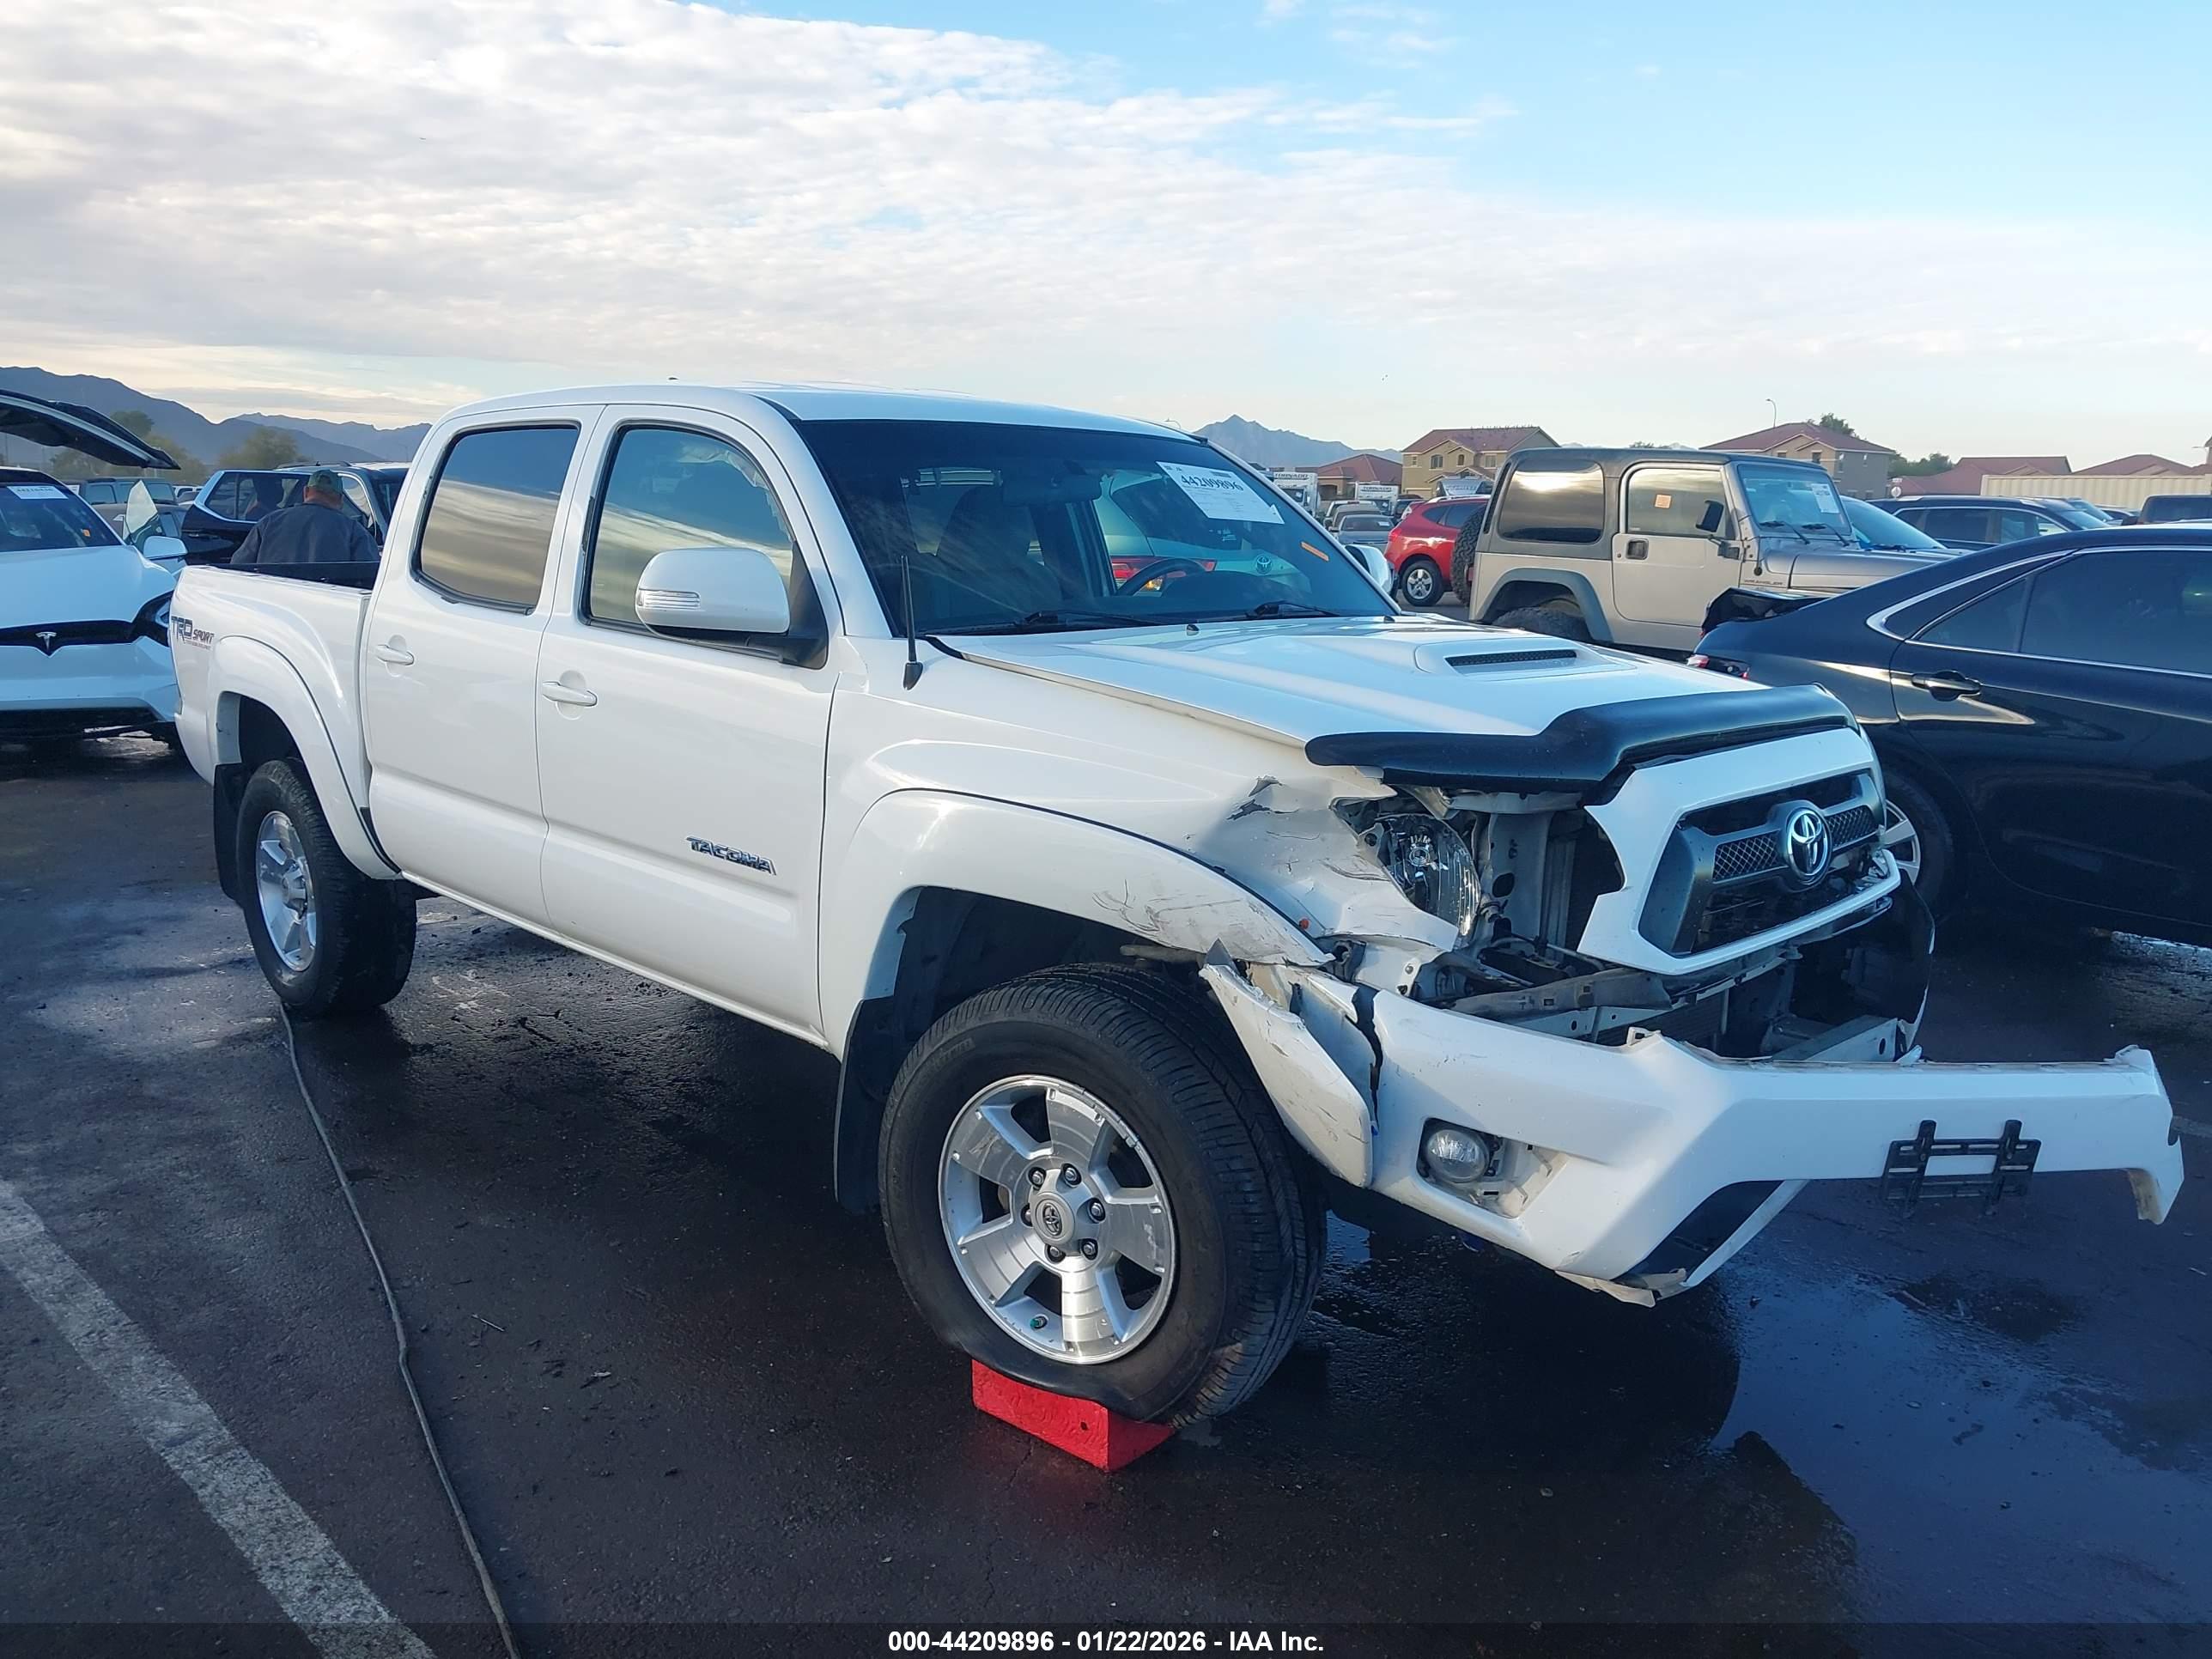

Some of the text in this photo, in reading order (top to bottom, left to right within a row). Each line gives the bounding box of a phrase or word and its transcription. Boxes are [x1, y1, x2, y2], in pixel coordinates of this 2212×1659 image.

[1181, 474, 1244, 491] 44209896
[171, 615, 215, 645] TRD SPORT
[686, 836, 777, 876] TACOMA
